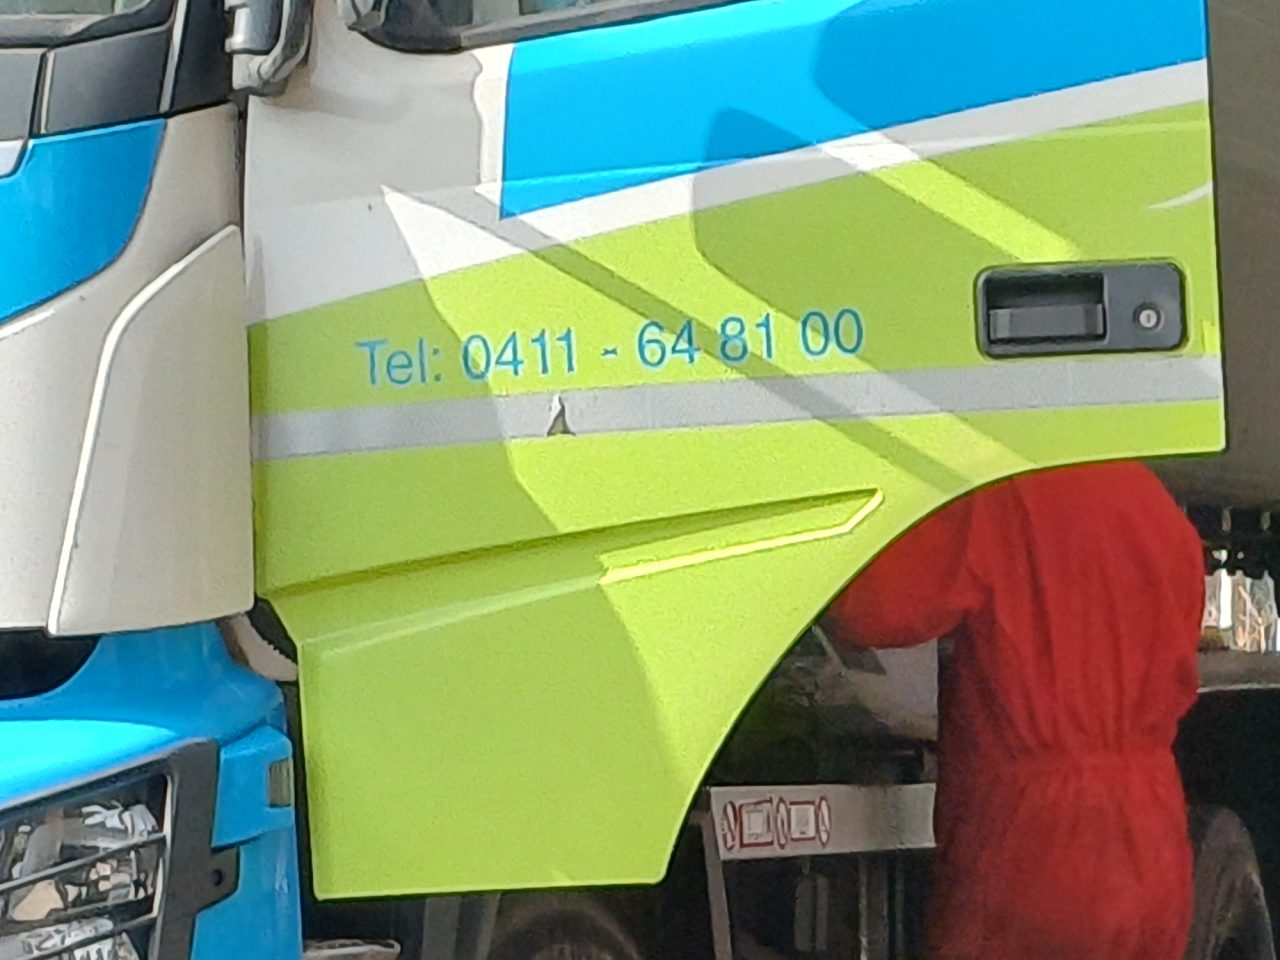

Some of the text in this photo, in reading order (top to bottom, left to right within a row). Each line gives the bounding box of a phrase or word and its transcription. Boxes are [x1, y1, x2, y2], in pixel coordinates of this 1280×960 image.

[355, 337, 442, 386] Tel:
[462, 327, 575, 380] 0411
[637, 319, 701, 368] 64
[719, 312, 773, 362] 81
[800, 308, 864, 356] 00
